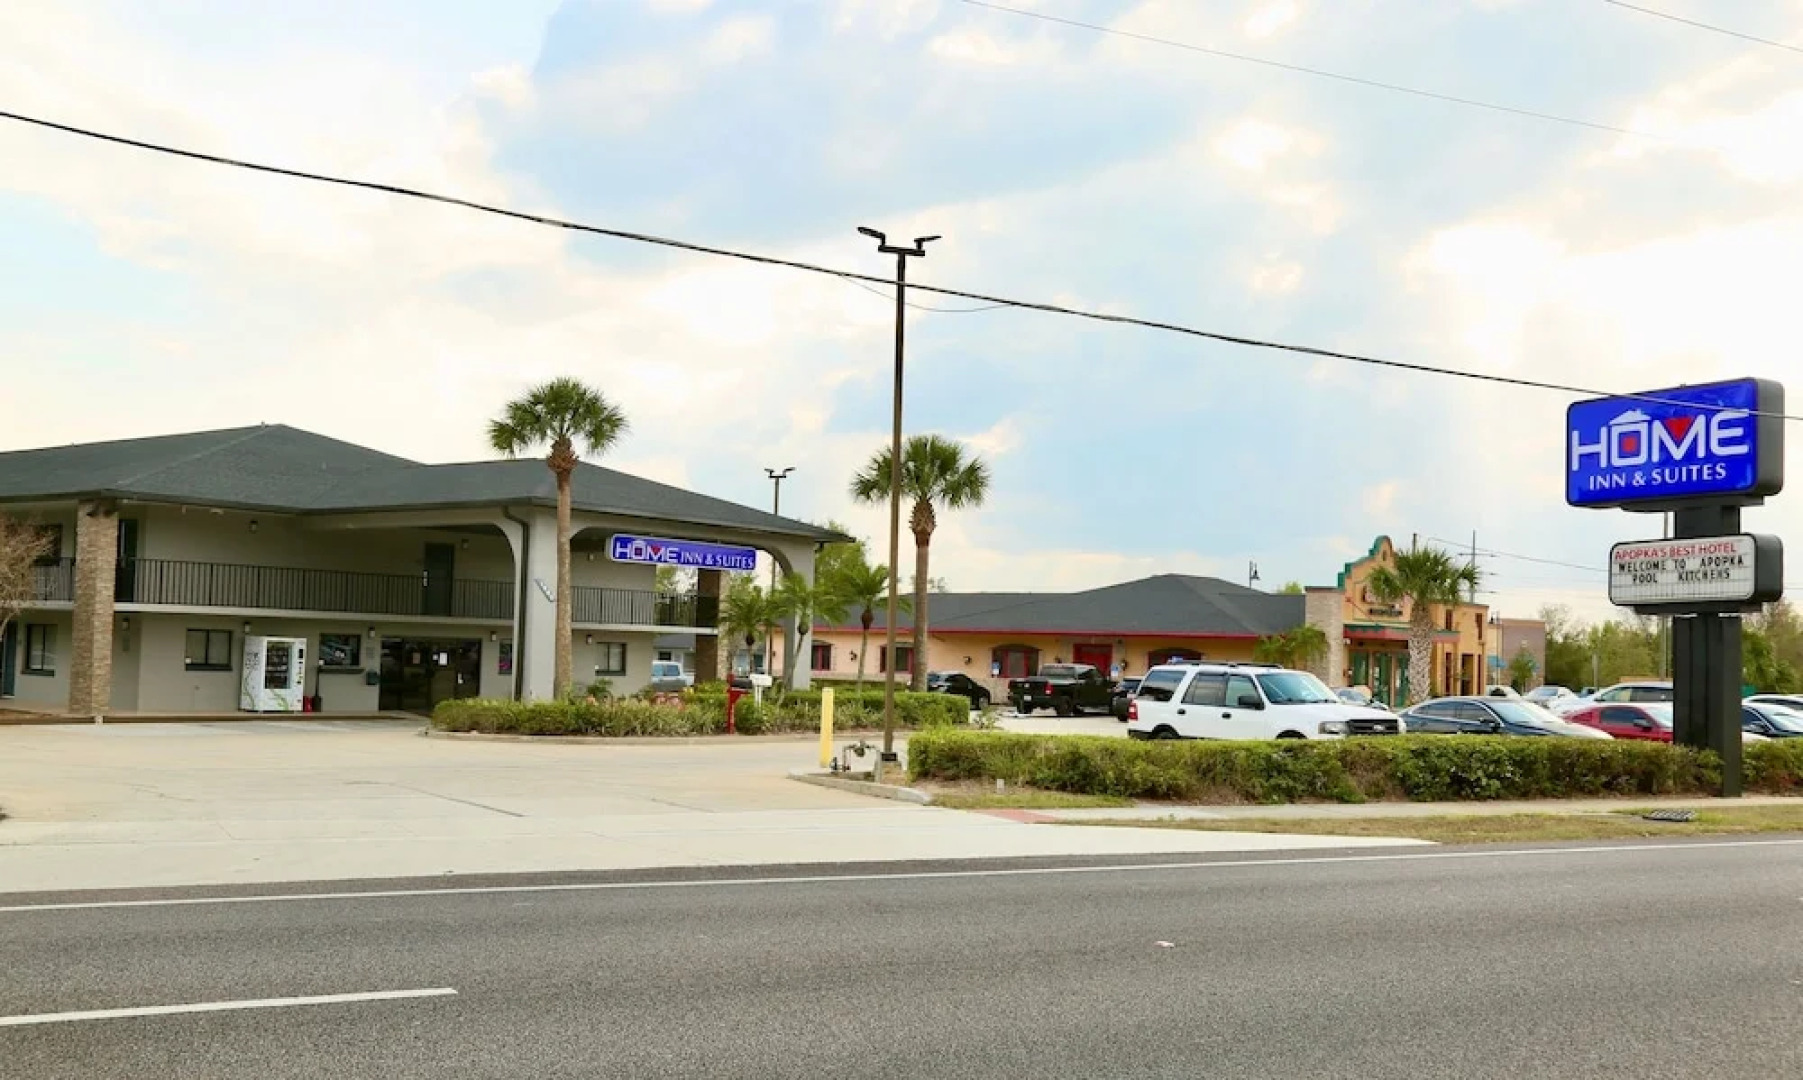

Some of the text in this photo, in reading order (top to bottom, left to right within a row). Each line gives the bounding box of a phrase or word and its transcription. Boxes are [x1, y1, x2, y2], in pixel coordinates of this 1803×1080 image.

[1571, 409, 1749, 471] HOME
[1589, 462, 1727, 491] INN & SUITES
[614, 540, 753, 569] HOME INN & SUITES
[1614, 542, 1737, 561] APOPKA'S BEST HOTEL
[1619, 554, 1743, 573] WELCOME TO APOPKA
[1632, 567, 1730, 583] POOL KITCHENS
